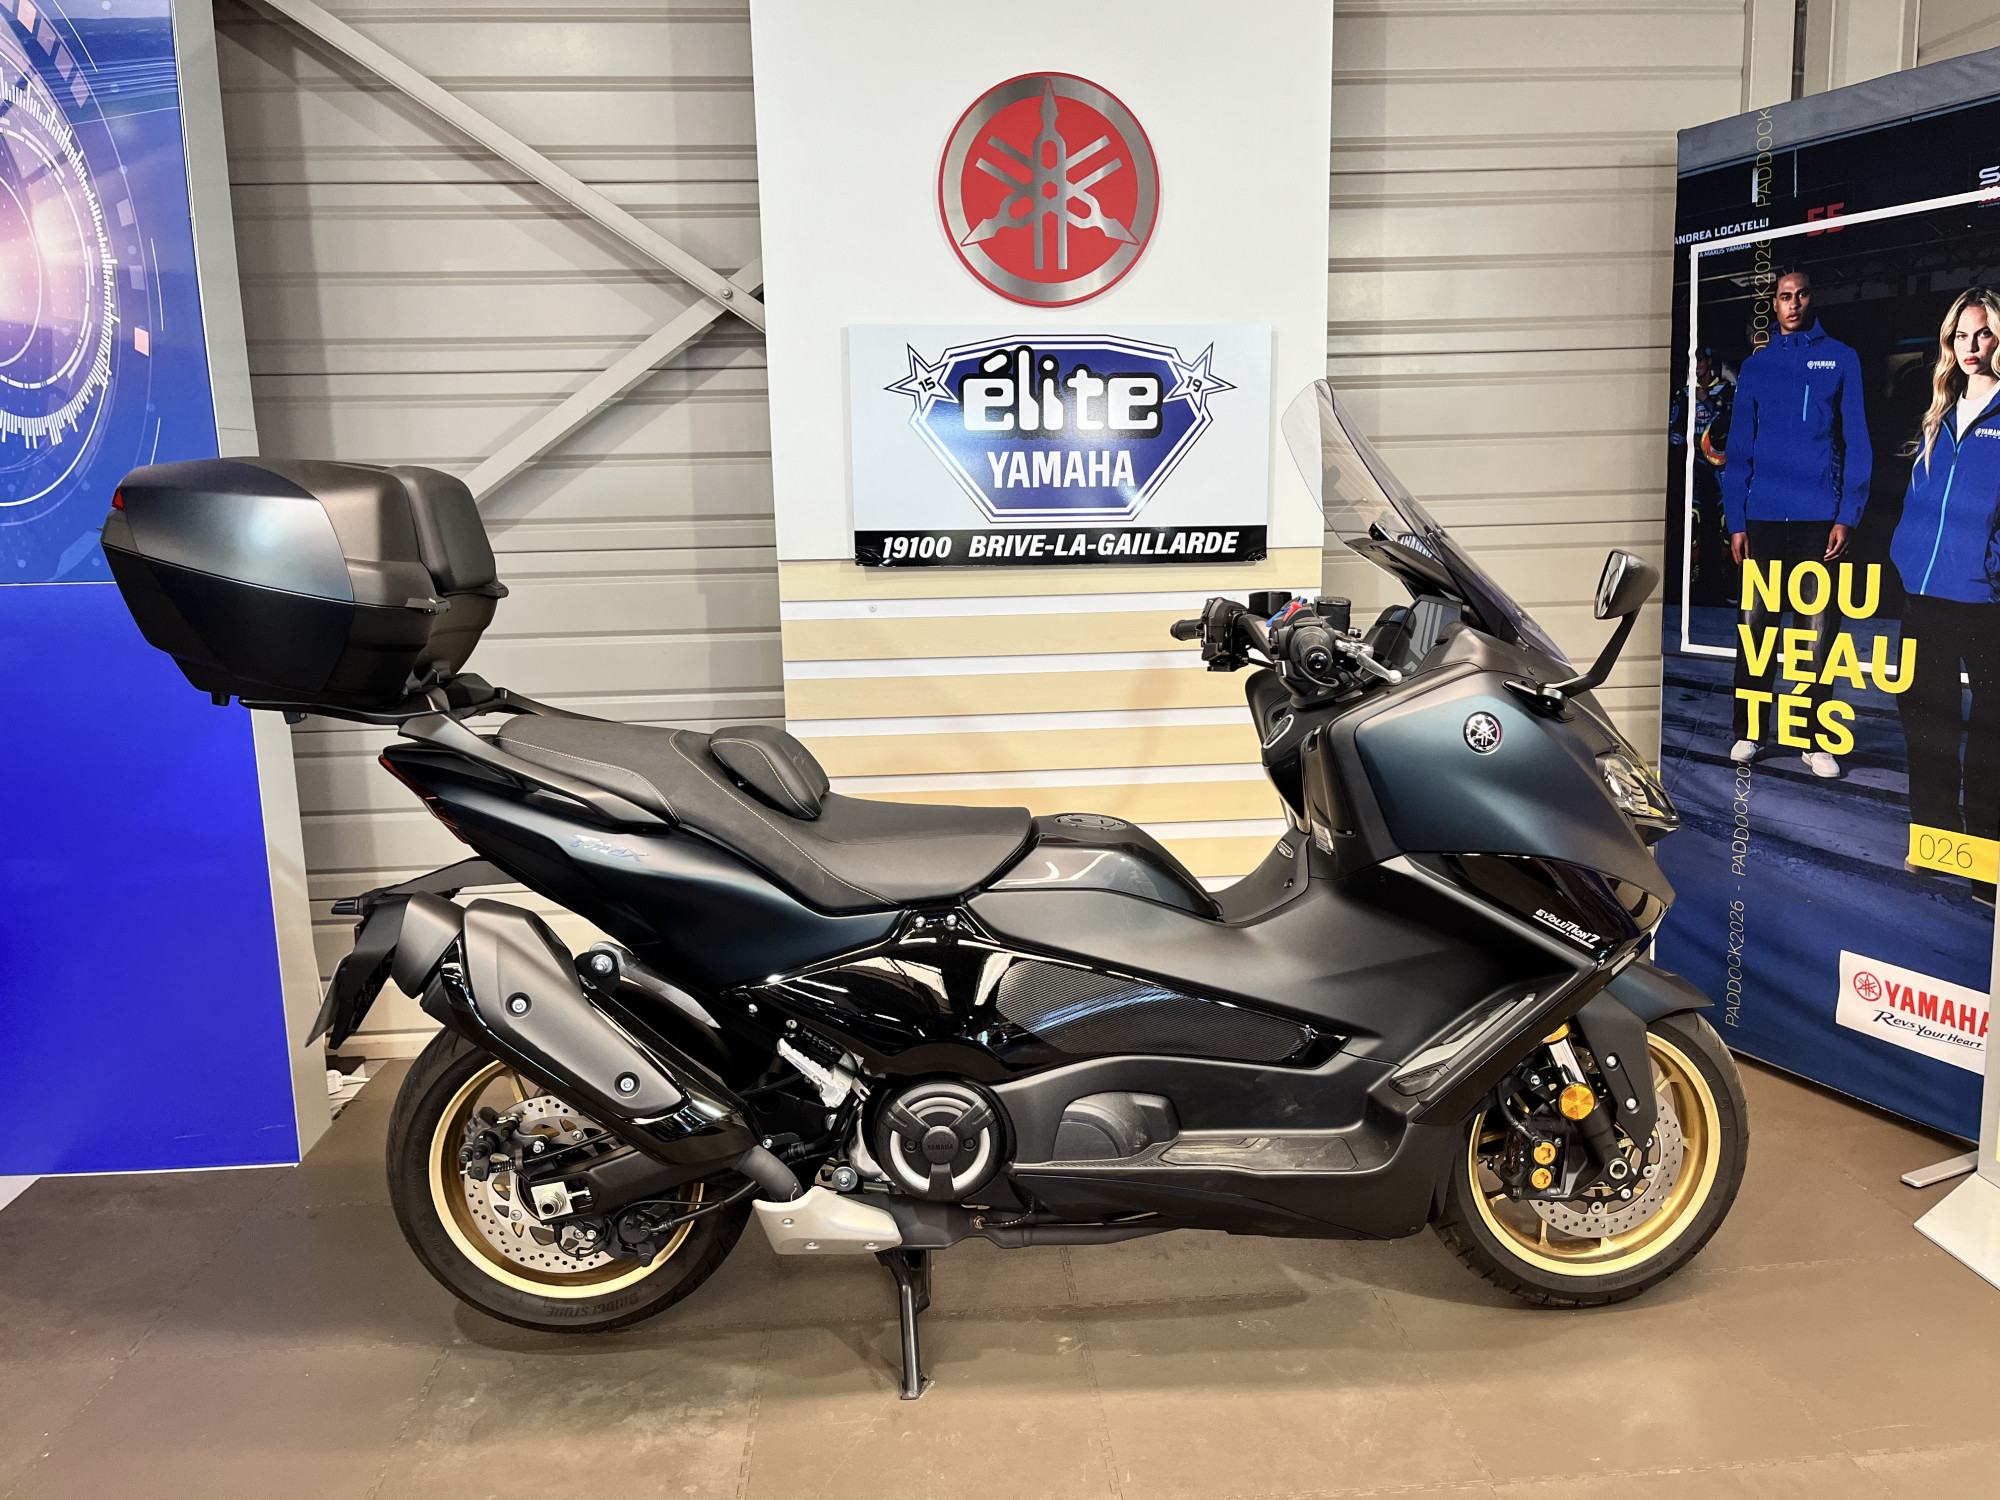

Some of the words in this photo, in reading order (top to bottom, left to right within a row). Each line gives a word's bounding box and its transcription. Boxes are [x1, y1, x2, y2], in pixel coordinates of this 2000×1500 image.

[1755, 107, 1773, 208] PADDOCK
[1714, 217, 1769, 237] LOCATELLI
[918, 377, 937, 392] 15
[1186, 375, 1203, 393] 19
[986, 450, 1136, 489] YAMAHA
[882, 536, 952, 559] 19100
[967, 531, 1240, 558] BRIVE-LA-GAILLARDE
[1740, 558, 1882, 620] NOU
[1737, 623, 1918, 694] VEAU
[1735, 682, 1856, 756] TÉS
[1919, 833, 1973, 869] 026
[1725, 899, 1745, 1028] PADDOCK2026
[1873, 1009, 1915, 1029] Revs
[1916, 1023, 1949, 1041] Your
[1884, 980, 1989, 1039] YAMAHA
[927, 1142, 954, 1152] YAMAHA
